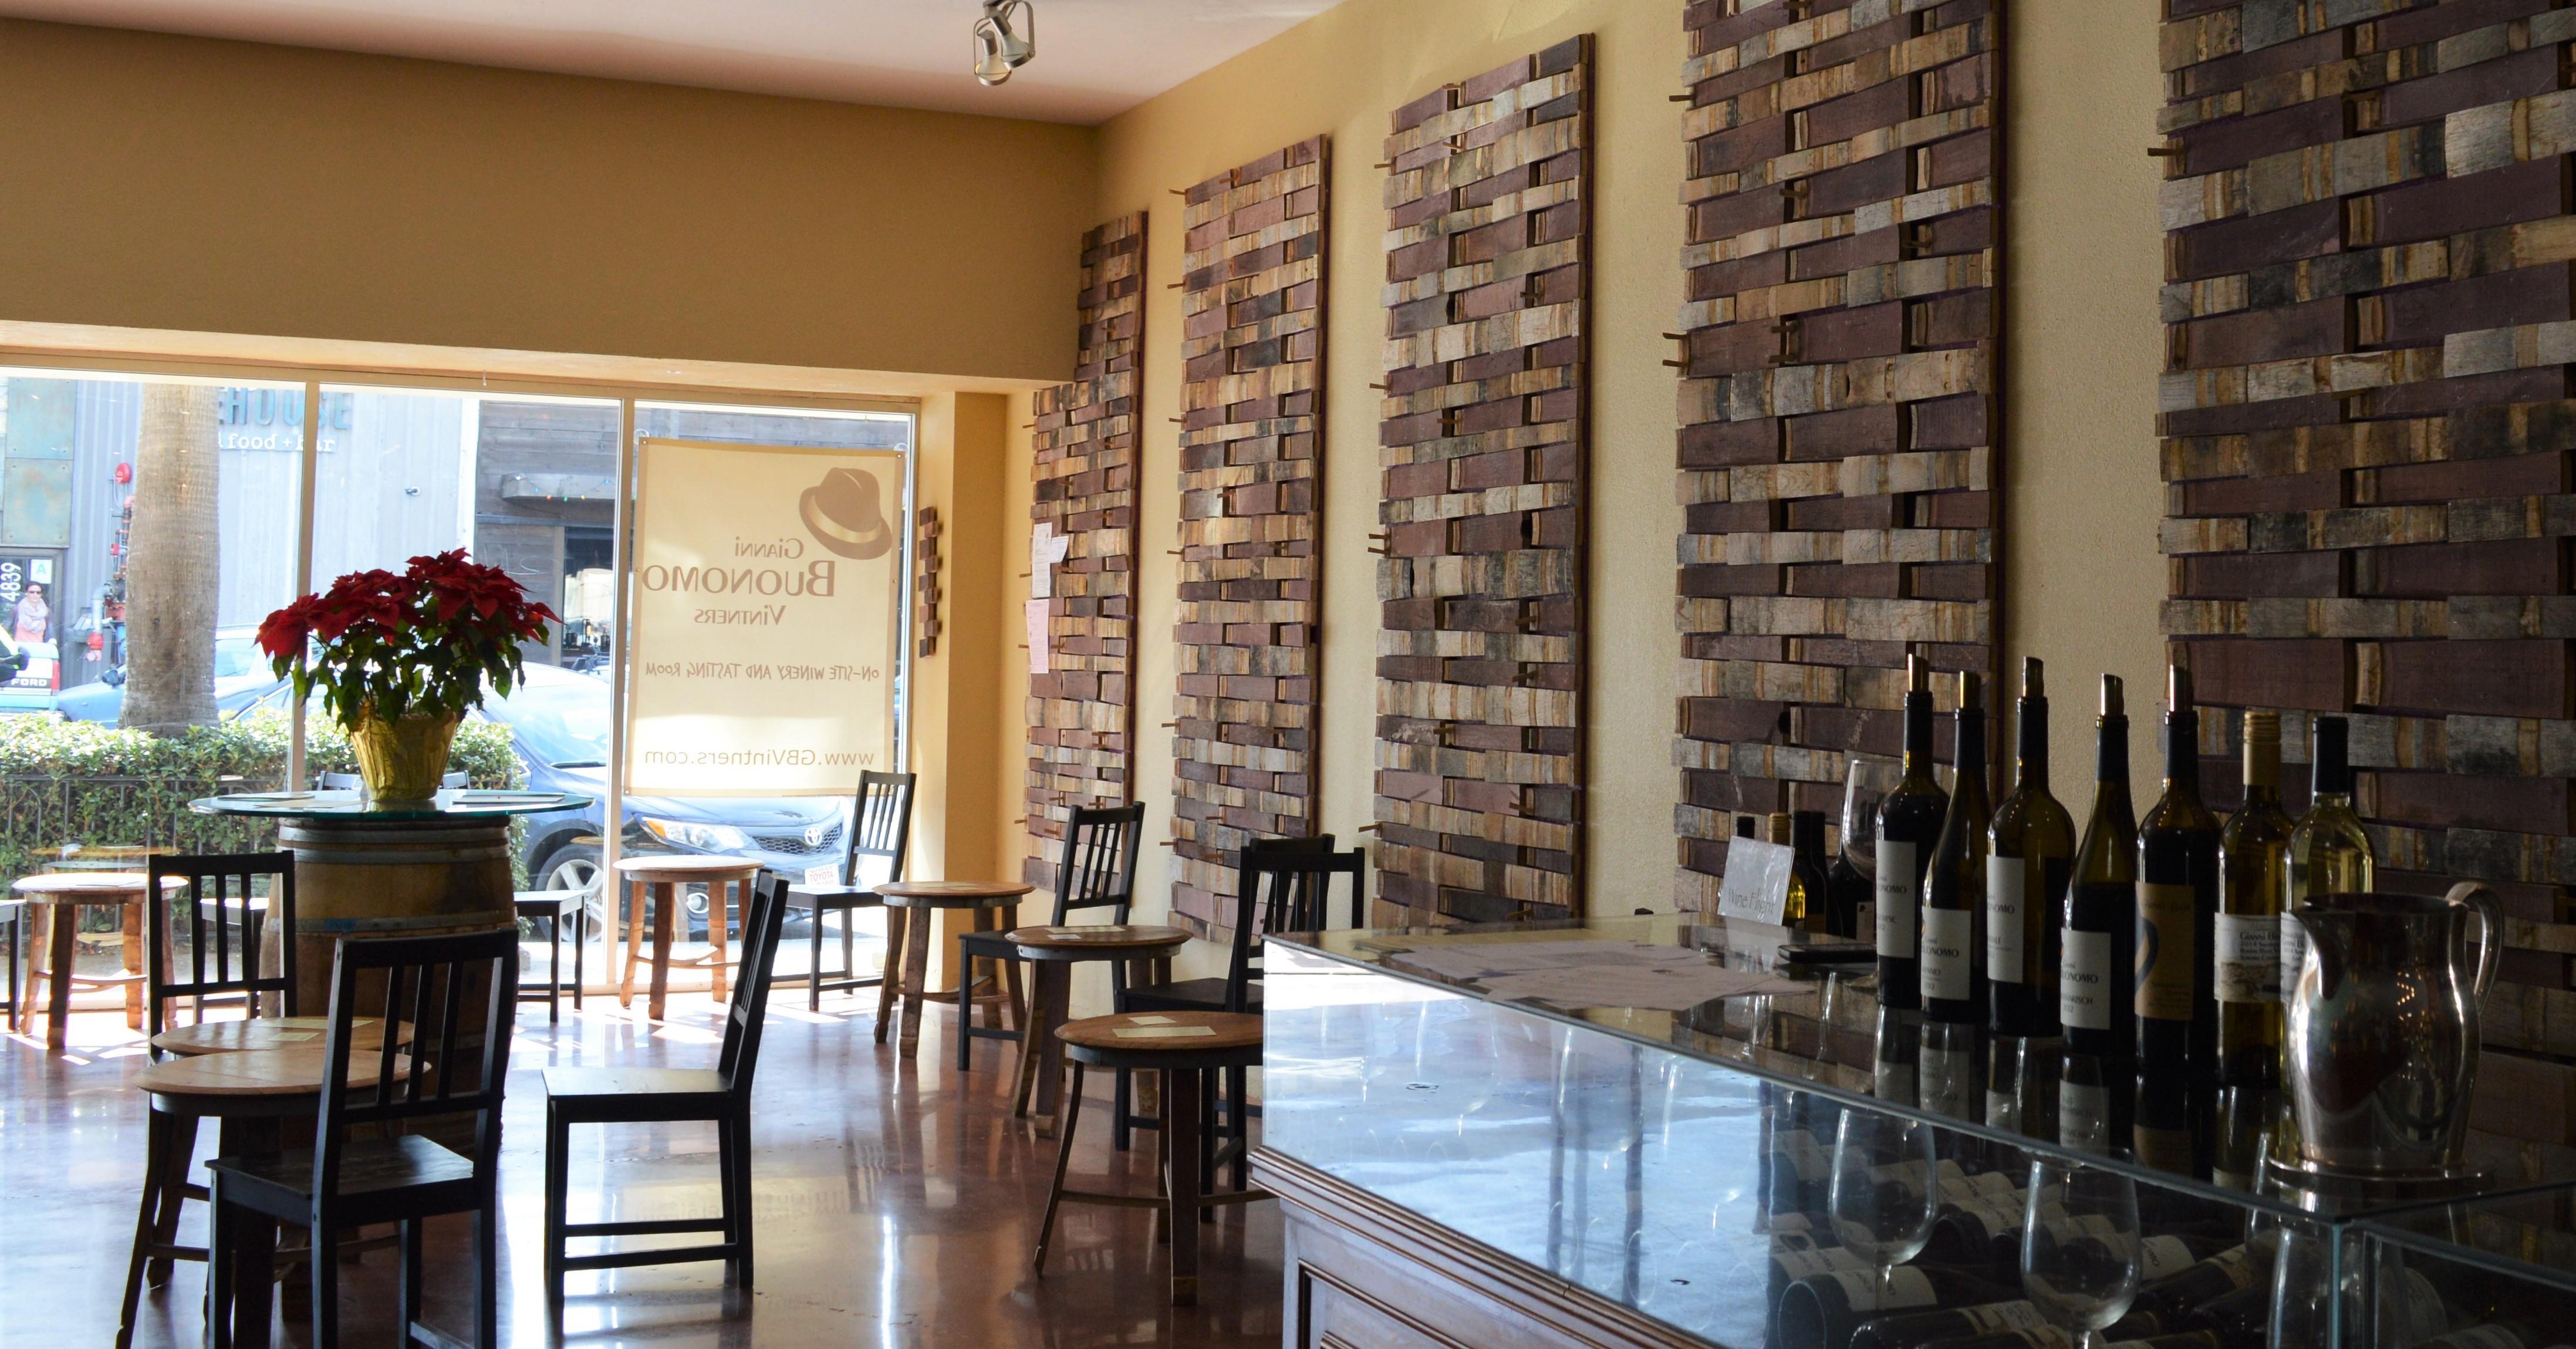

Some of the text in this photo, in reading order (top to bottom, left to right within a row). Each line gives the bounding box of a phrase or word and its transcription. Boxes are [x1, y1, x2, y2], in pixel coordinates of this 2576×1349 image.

[228, 433, 277, 450] food
[1, 562, 21, 602] 4839
[11, 678, 48, 686] FORD
[810, 871, 835, 883] TOYOTA
[1728, 886, 1775, 915] Wine Flight
